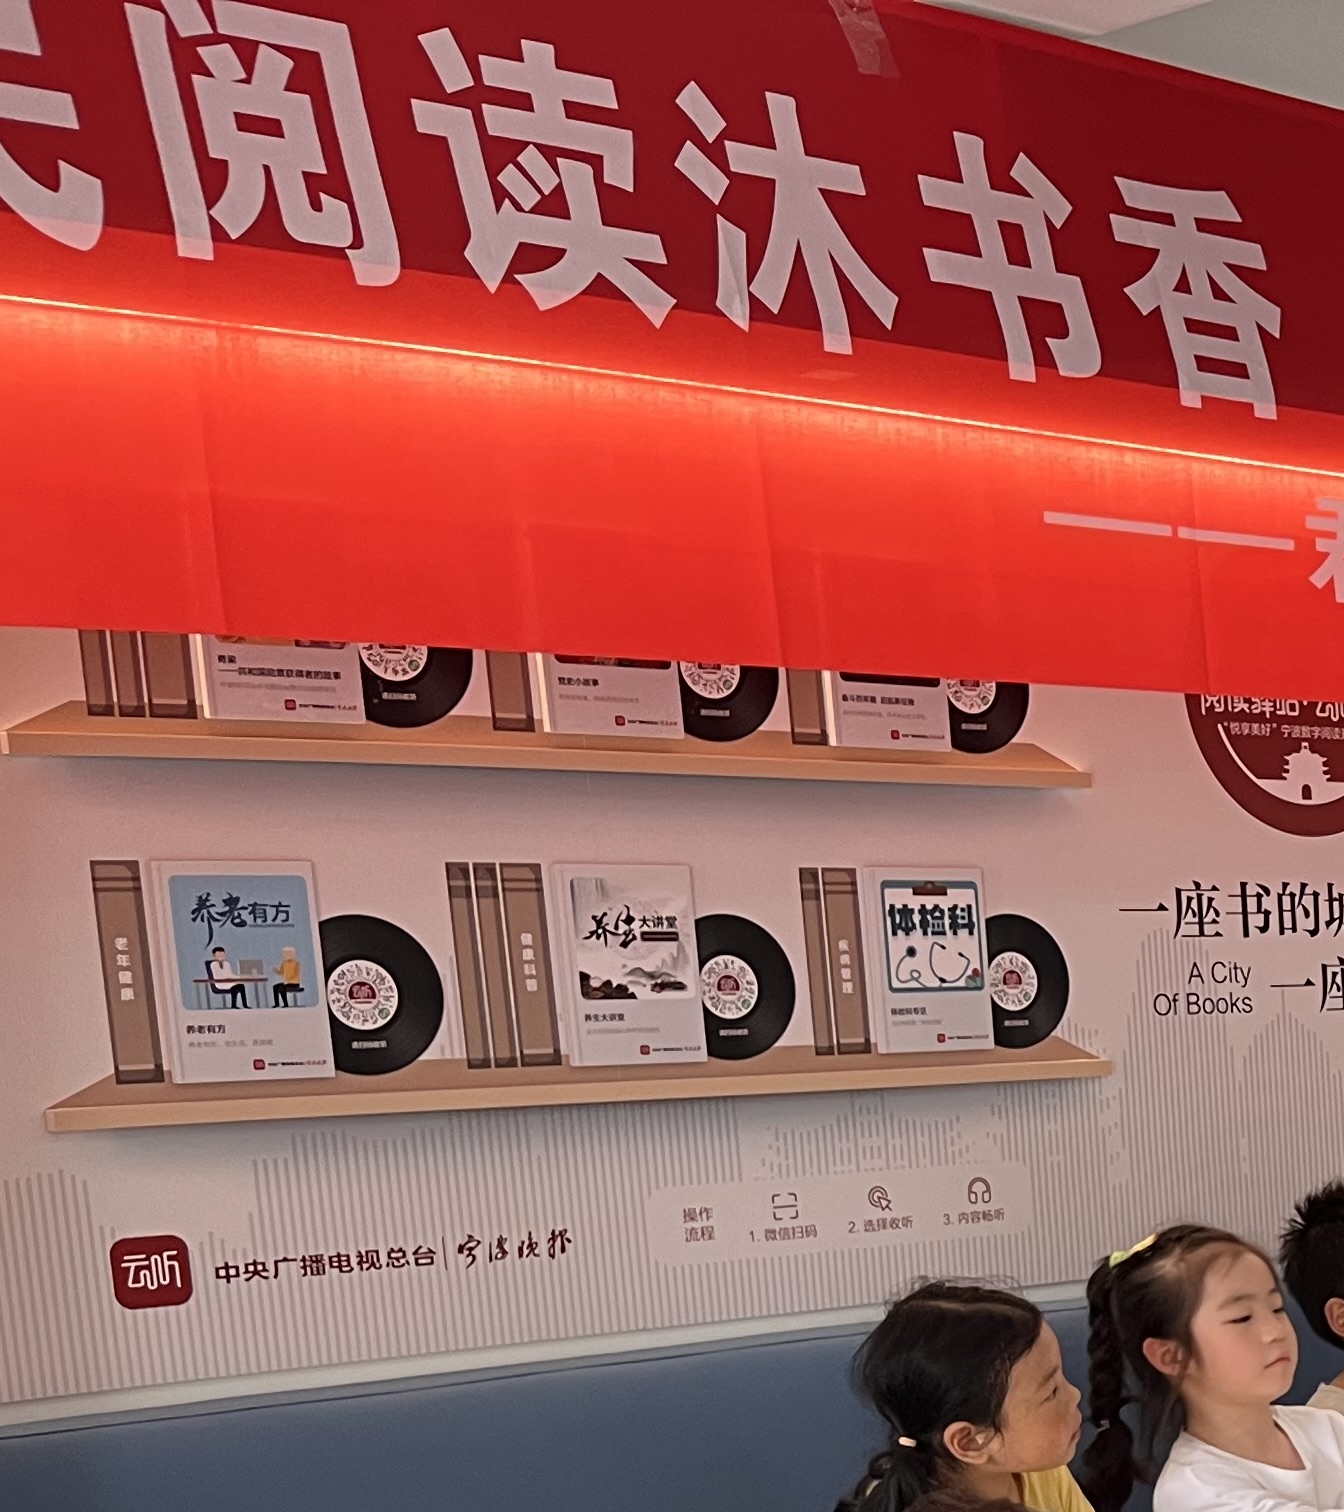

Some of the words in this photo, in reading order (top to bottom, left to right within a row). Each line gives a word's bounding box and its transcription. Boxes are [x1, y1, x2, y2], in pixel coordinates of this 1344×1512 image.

[190, 891, 293, 949] 养老有方
[583, 904, 678, 948] 养生大讲堂
[887, 902, 977, 938] 体检科
[1188, 963, 1205, 984] A
[1210, 960, 1252, 990] City
[1153, 992, 1180, 1017] Of
[1186, 991, 1254, 1016] Books
[682, 1206, 714, 1224] 操作
[863, 1214, 914, 1233] 选择收听
[957, 1208, 1006, 1226] 内容畅听
[684, 1225, 716, 1242] 流程
[764, 1224, 818, 1242] 微信扫码
[120, 1250, 184, 1290] 云听
[214, 1245, 438, 1285] 中央广播电视总台
